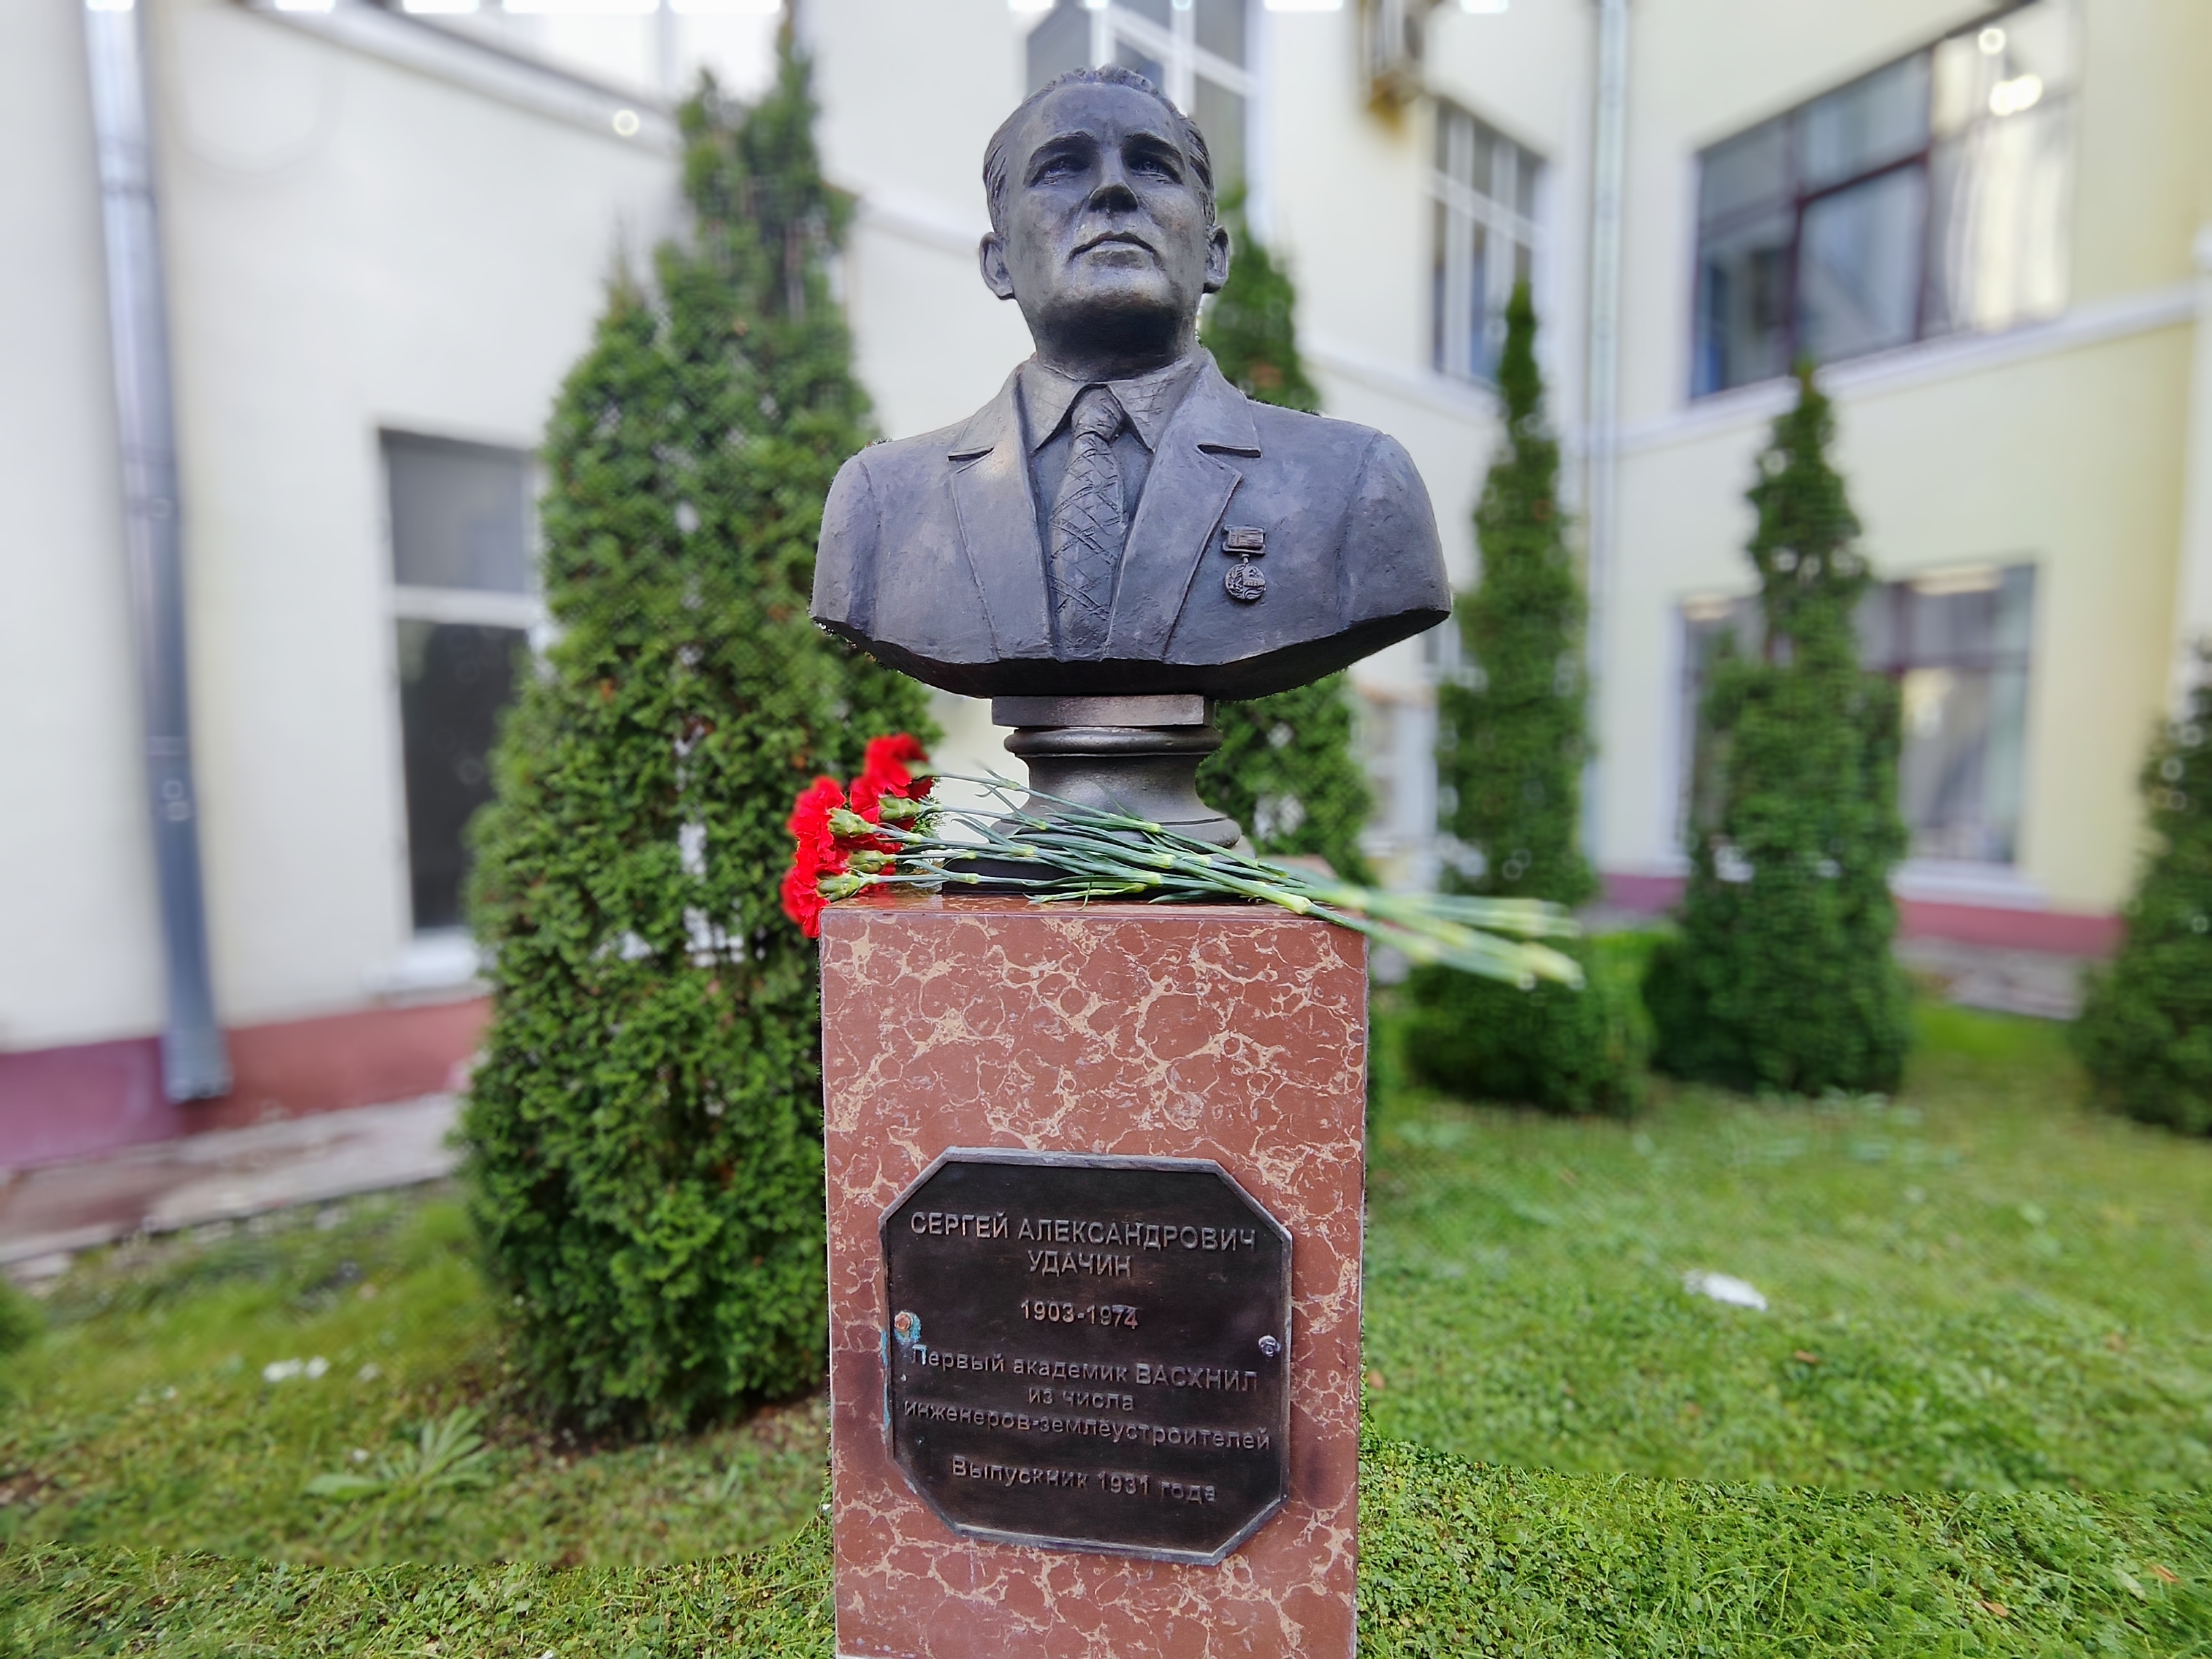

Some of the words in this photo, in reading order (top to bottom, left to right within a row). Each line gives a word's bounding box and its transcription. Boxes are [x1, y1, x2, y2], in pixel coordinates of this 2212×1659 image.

[911, 1212, 1008, 1239] СЕРГЕЙ
[1018, 1218, 1256, 1252] АЛЕКСАНДРОВИЧ
[1028, 1250, 1131, 1277] УДАЧИН
[1021, 1299, 1139, 1329] 1903-1974
[912, 1345, 1004, 1373] Первый
[1013, 1358, 1127, 1382] академик
[1136, 1363, 1258, 1391] ВАСХНИЛ
[1028, 1388, 1053, 1404] из
[1063, 1391, 1134, 1410] числа
[904, 1399, 1270, 1450] инженеров-землеустроителей
[952, 1456, 1086, 1488] Выпускник
[1098, 1471, 1149, 1495] 1931
[1161, 1480, 1216, 1503] года
